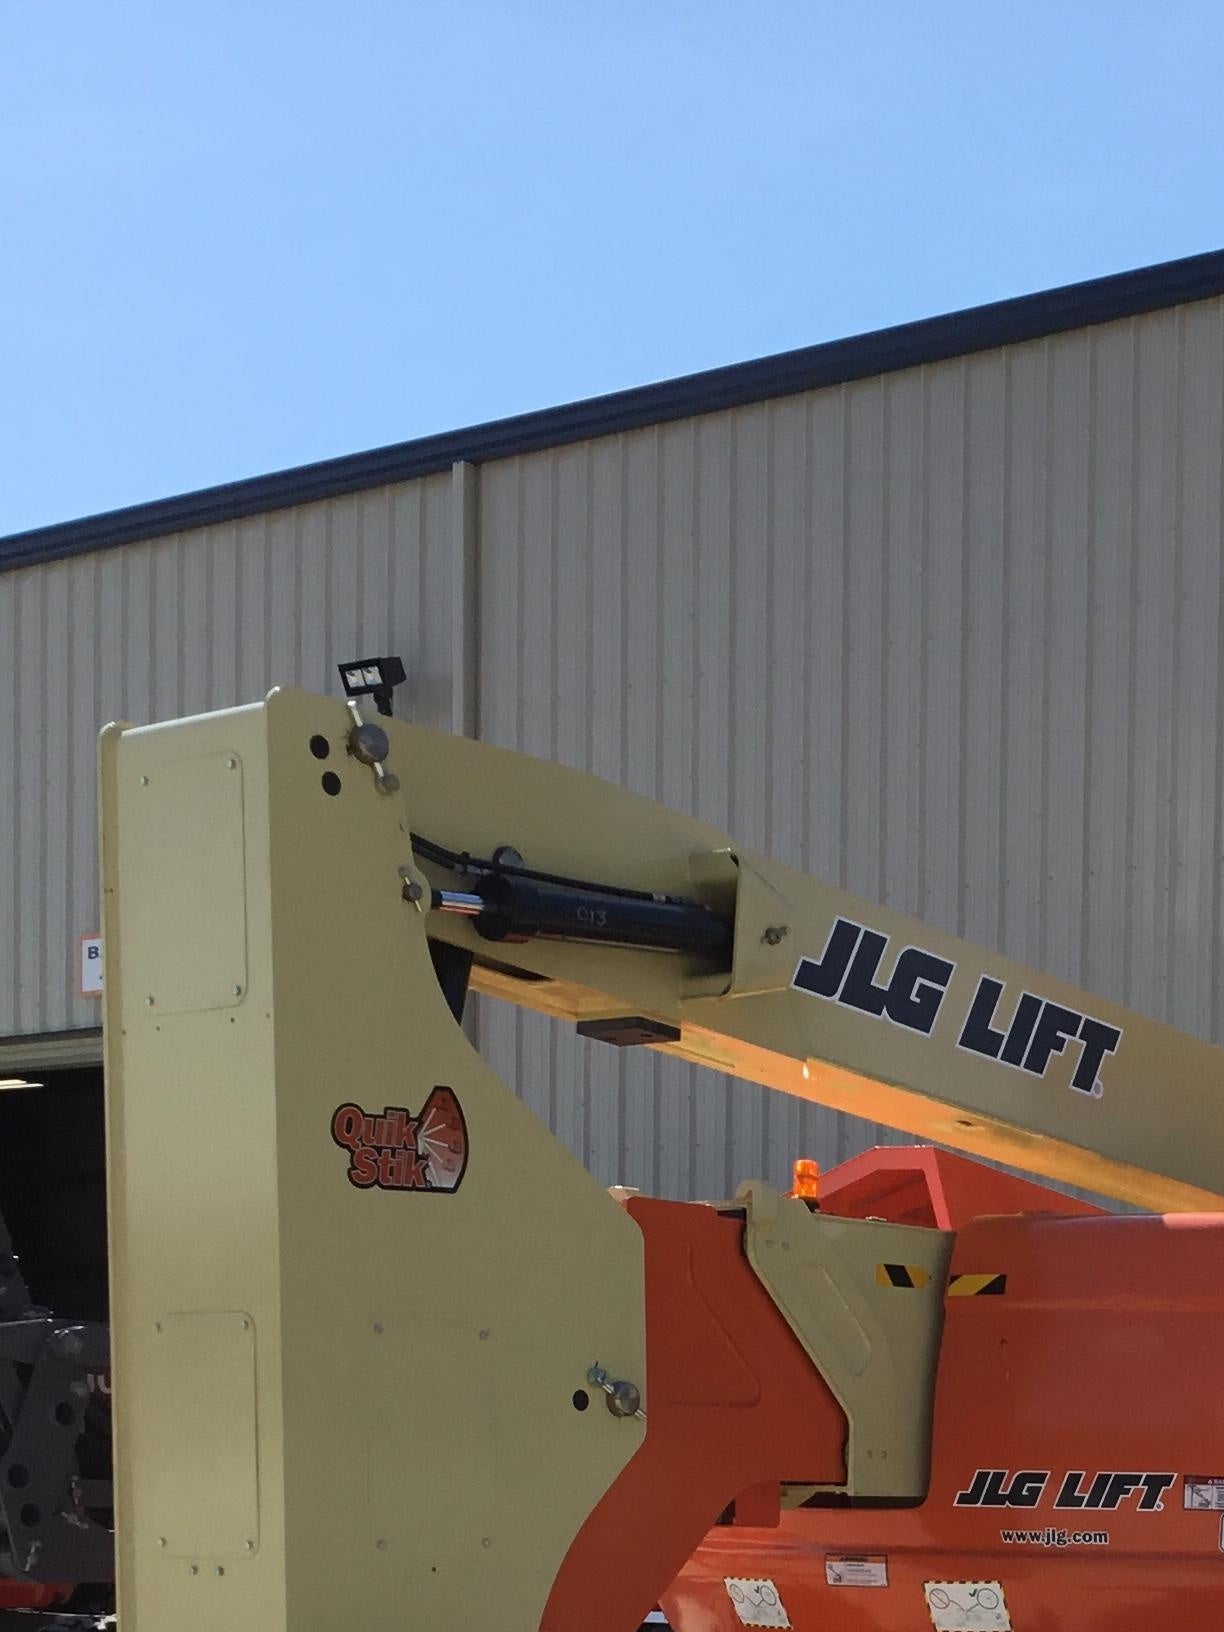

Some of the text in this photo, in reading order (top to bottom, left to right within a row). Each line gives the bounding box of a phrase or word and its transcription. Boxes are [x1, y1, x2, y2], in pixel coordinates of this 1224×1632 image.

[791, 915, 1124, 1098] JLG LIFT
[334, 1106, 418, 1150] Quik
[350, 1146, 428, 1187] Stik
[952, 1469, 1051, 1509] JLG
[1052, 1470, 1178, 1512] LIFT
[1001, 1527, 1109, 1547] www.jlg.com
